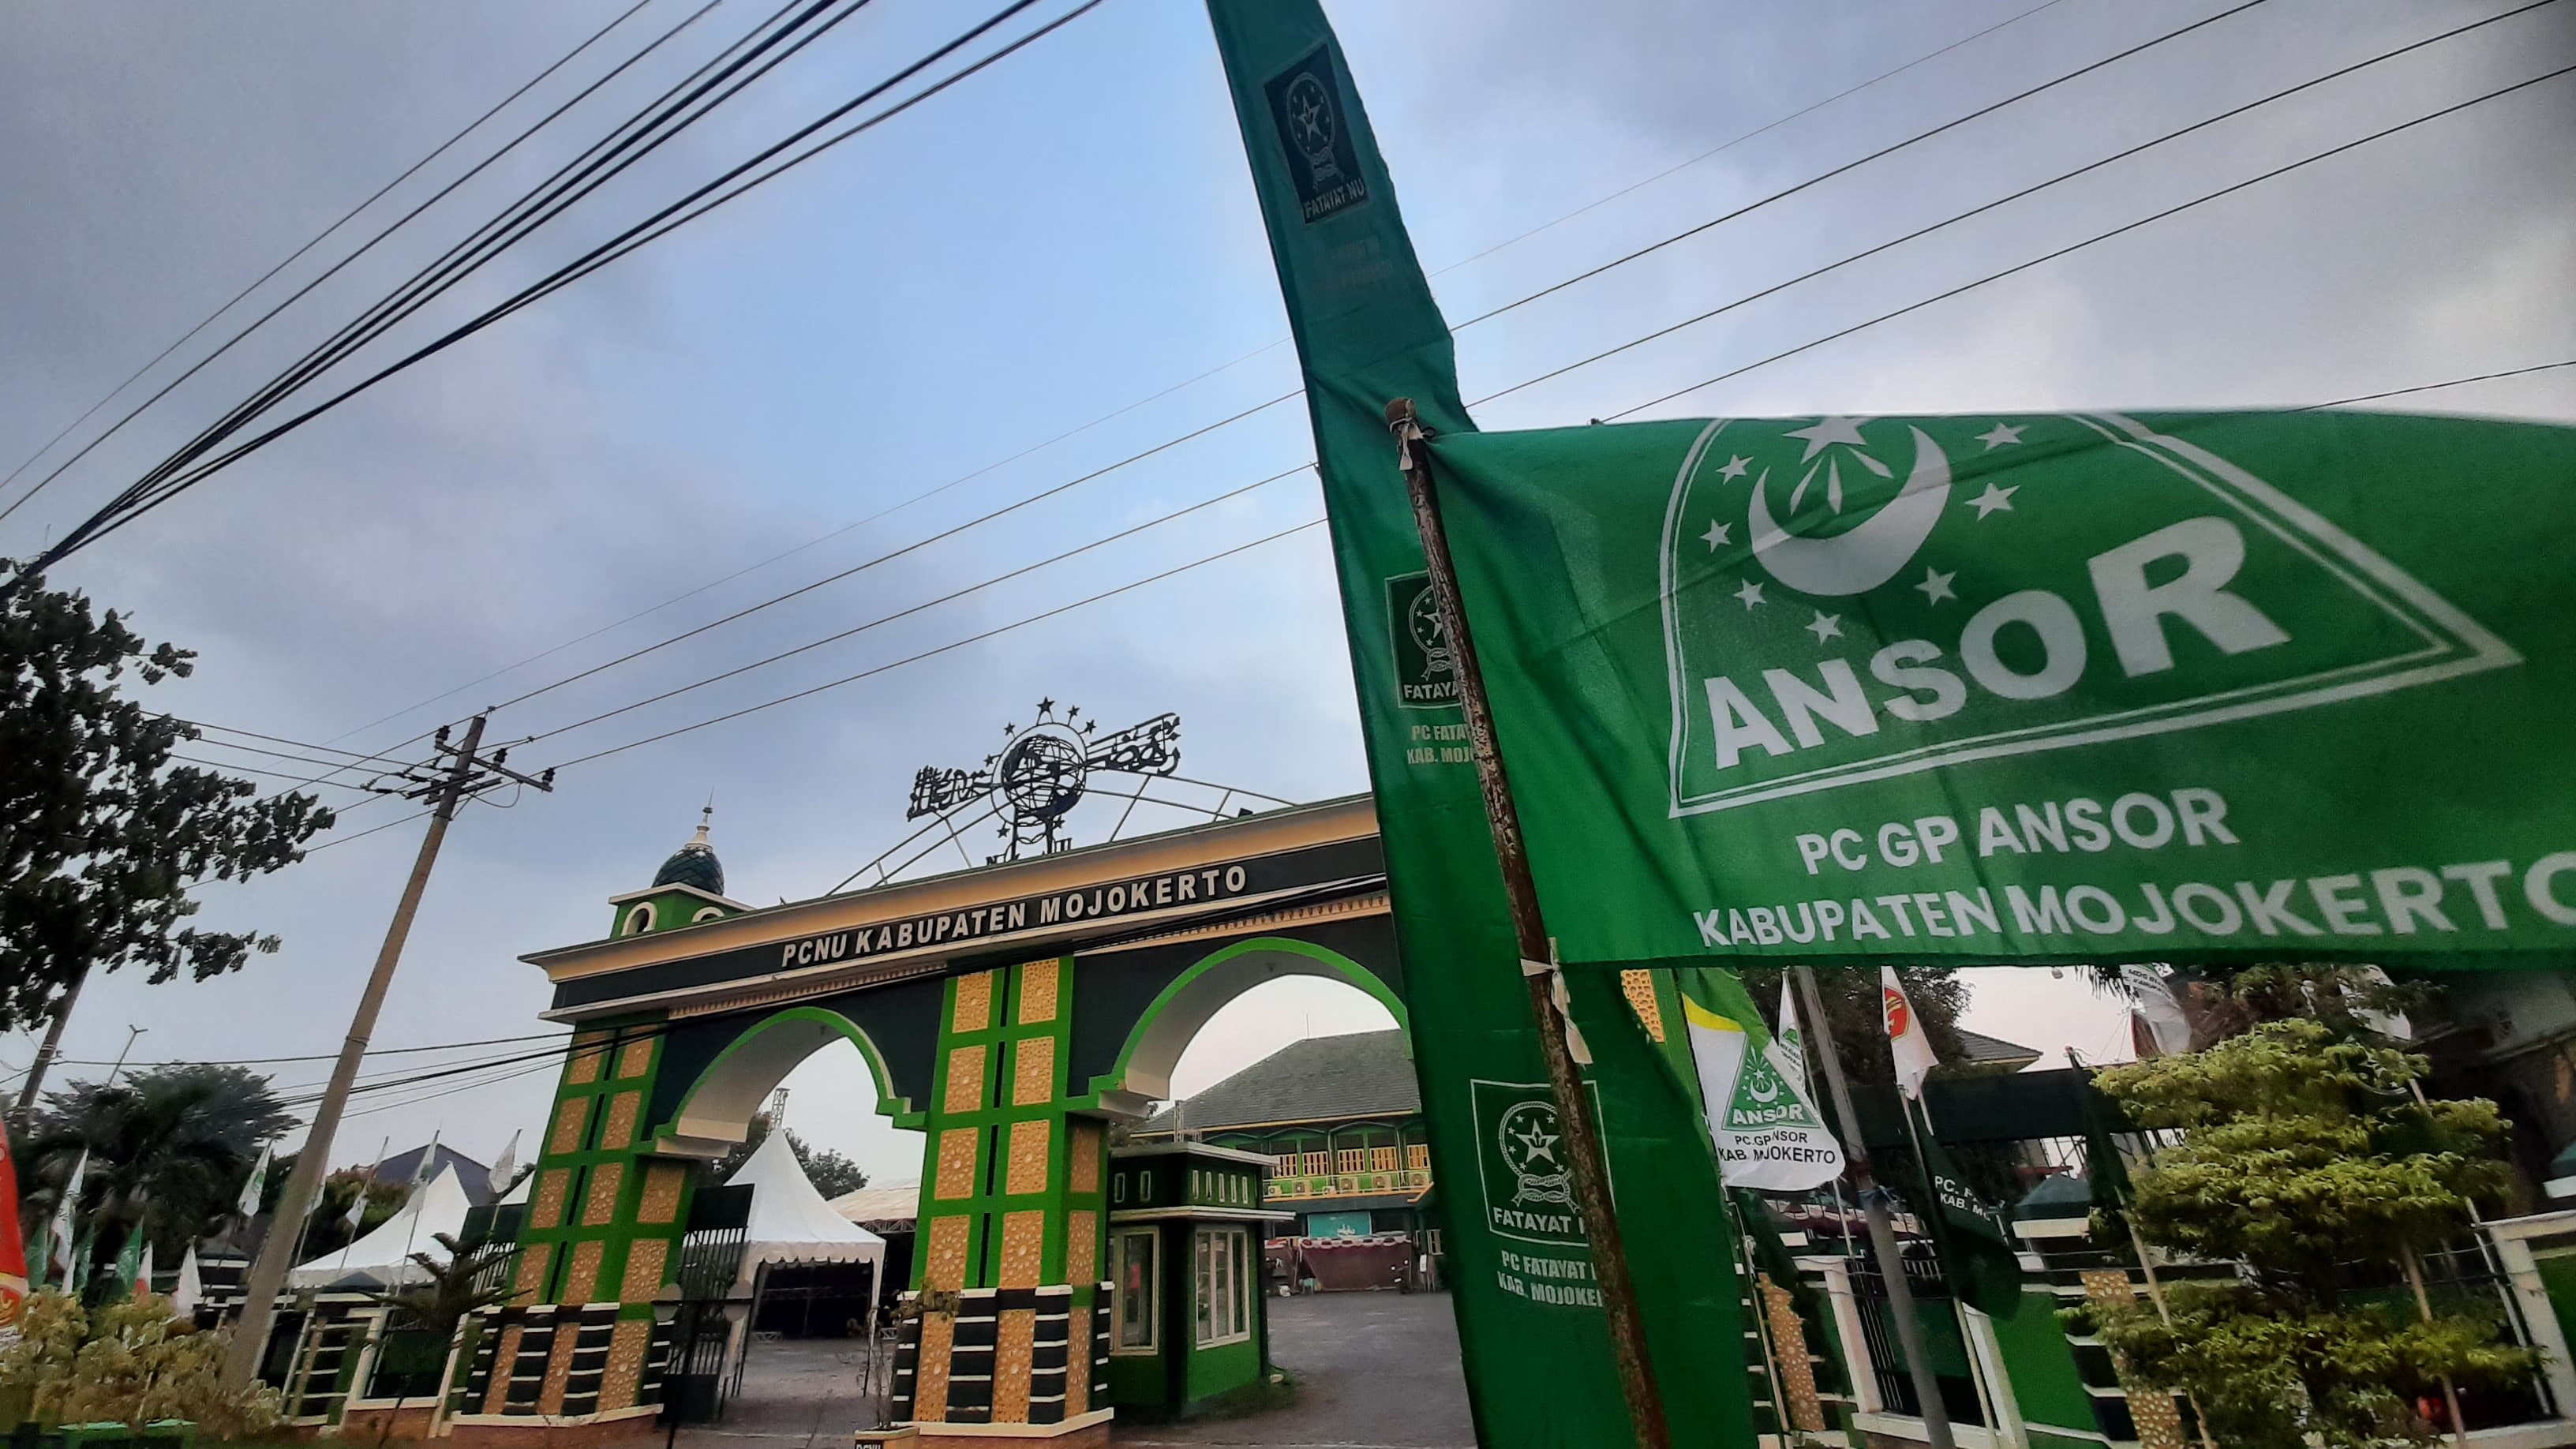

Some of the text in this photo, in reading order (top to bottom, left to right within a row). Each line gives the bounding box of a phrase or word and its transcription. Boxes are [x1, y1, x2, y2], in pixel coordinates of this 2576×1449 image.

[1304, 178, 1365, 218] FATAYAT NU
[1703, 515, 2290, 772] ANSOR
[1404, 681, 1458, 699] FATAYA
[1412, 724, 1470, 740] PC FATA
[1407, 747, 1438, 764] KAB.
[1795, 788, 2241, 875] PC GP ANSOR
[1693, 850, 2576, 948] KABUPATEN MOJOKERTO
[781, 865, 1246, 968] PCNU KABUPATEN MOJOKERTO
[1732, 1103, 1805, 1125] ANSOR
[1772, 1129, 1808, 1144] NSOR
[1754, 1146, 1836, 1164] MJOKERTO
[1934, 1175, 1959, 1194] PC.
[1940, 1193, 1968, 1210] KAB.
[1492, 1207, 1572, 1234] FATAYAT
[1501, 1249, 1520, 1271] PC
[1522, 1256, 1586, 1279] FATAYAT
